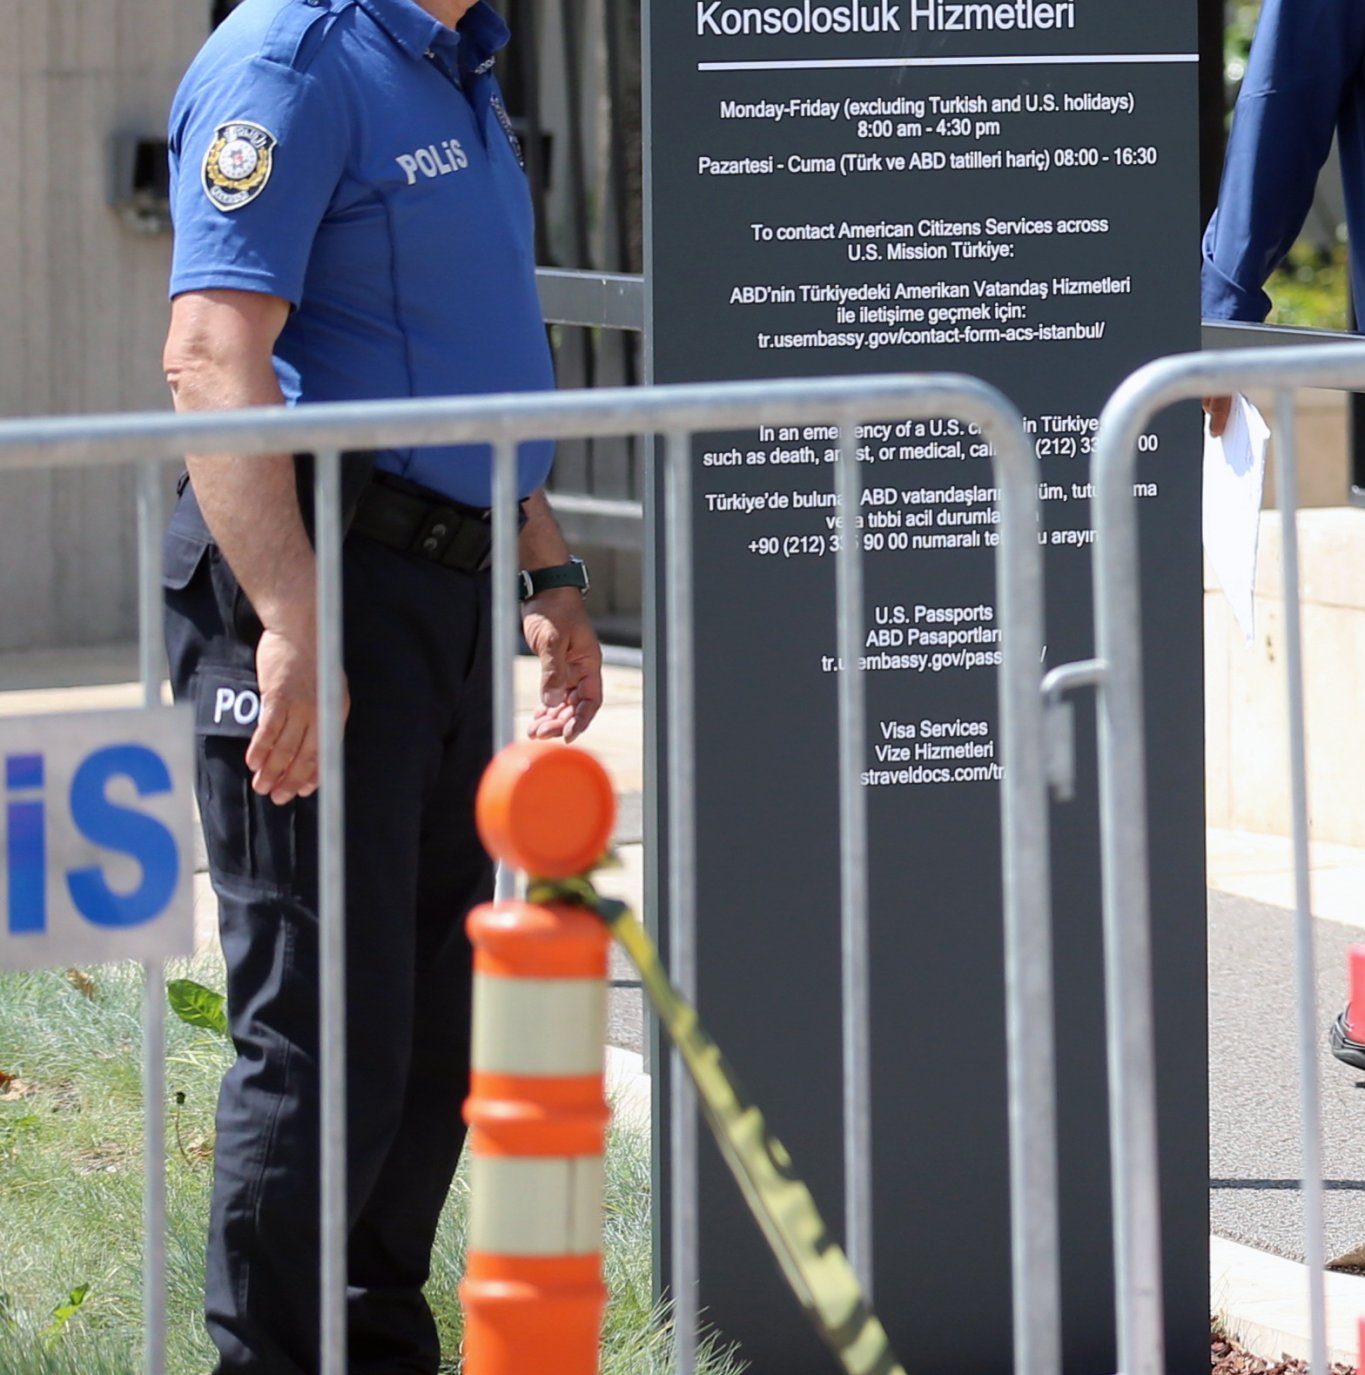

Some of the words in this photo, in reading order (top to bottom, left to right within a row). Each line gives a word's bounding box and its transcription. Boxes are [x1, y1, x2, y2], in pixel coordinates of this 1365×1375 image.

[721, 99, 840, 121] Monday-Friday
[844, 97, 924, 119] (excluding
[929, 96, 987, 113] Turkish
[992, 95, 1021, 112] and
[1026, 94, 1059, 111] U.S.
[1064, 93, 1134, 113] holidays)
[858, 120, 892, 137] 8:00
[897, 123, 921, 137] am
[936, 118, 971, 135] 4:30
[976, 122, 1000, 139] pm
[699, 156, 773, 174] Pazartesi
[788, 156, 835, 172] Cuma
[840, 154, 882, 175] (Türk
[886, 157, 905, 170] ve
[909, 152, 946, 169] ABD
[950, 151, 1001, 168] tatilleri
[1006, 150, 1050, 171] hariç)
[1054, 149, 1098, 166] 08:00
[1114, 147, 1156, 164] 16:30
[751, 224, 773, 240] To
[777, 224, 835, 240] contact
[838, 221, 913, 238] American
[918, 220, 981, 236] Citizens
[985, 218, 1053, 234] Services
[1057, 220, 1108, 233] across
[848, 244, 882, 260] U.S.
[888, 243, 947, 259] Mission
[951, 241, 1013, 261] Türkiye:
[730, 286, 795, 303] ABD'nin
[799, 283, 890, 304] Türkiyedeki
[894, 282, 969, 299] Amerikan
[973, 279, 1048, 299] Vatandaş
[1053, 277, 1130, 294] Hizmetleri
[837, 307, 855, 323] ile
[860, 306, 924, 326] iletişime
[928, 303, 991, 325] geçmek
[995, 302, 1026, 322] için:
[758, 322, 1105, 349] tr.usembassy.gov/contact-form-acs-istanbul/
[760, 425, 775, 442] In
[779, 427, 799, 441] an
[803, 425, 892, 442] emeency
[895, 420, 911, 437] of
[915, 423, 925, 437] a
[929, 419, 965, 436] U.S.
[703, 449, 741, 466] such
[746, 451, 766, 464] as
[770, 447, 819, 465] death,
[824, 444, 875, 463] arst,
[879, 447, 895, 461] or
[899, 442, 965, 461] medical,
[1035, 437, 1077, 459] (212)
[1138, 434, 1158, 451] 00
[860, 488, 898, 506] ABD
[868, 511, 902, 528] tıbbi
[905, 509, 933, 527] acil
[748, 536, 779, 555] +90
[783, 535, 825, 557] (212)
[864, 533, 884, 551] 90
[887, 532, 908, 550] 00
[912, 530, 981, 549] numaralı
[876, 606, 909, 624] U.S.
[915, 605, 993, 625] Passports
[866, 629, 903, 647] ABD
[880, 722, 915, 739] Visa
[920, 719, 988, 737] Services
[875, 745, 910, 761] Vize
[915, 741, 993, 760] Hizmetleri
